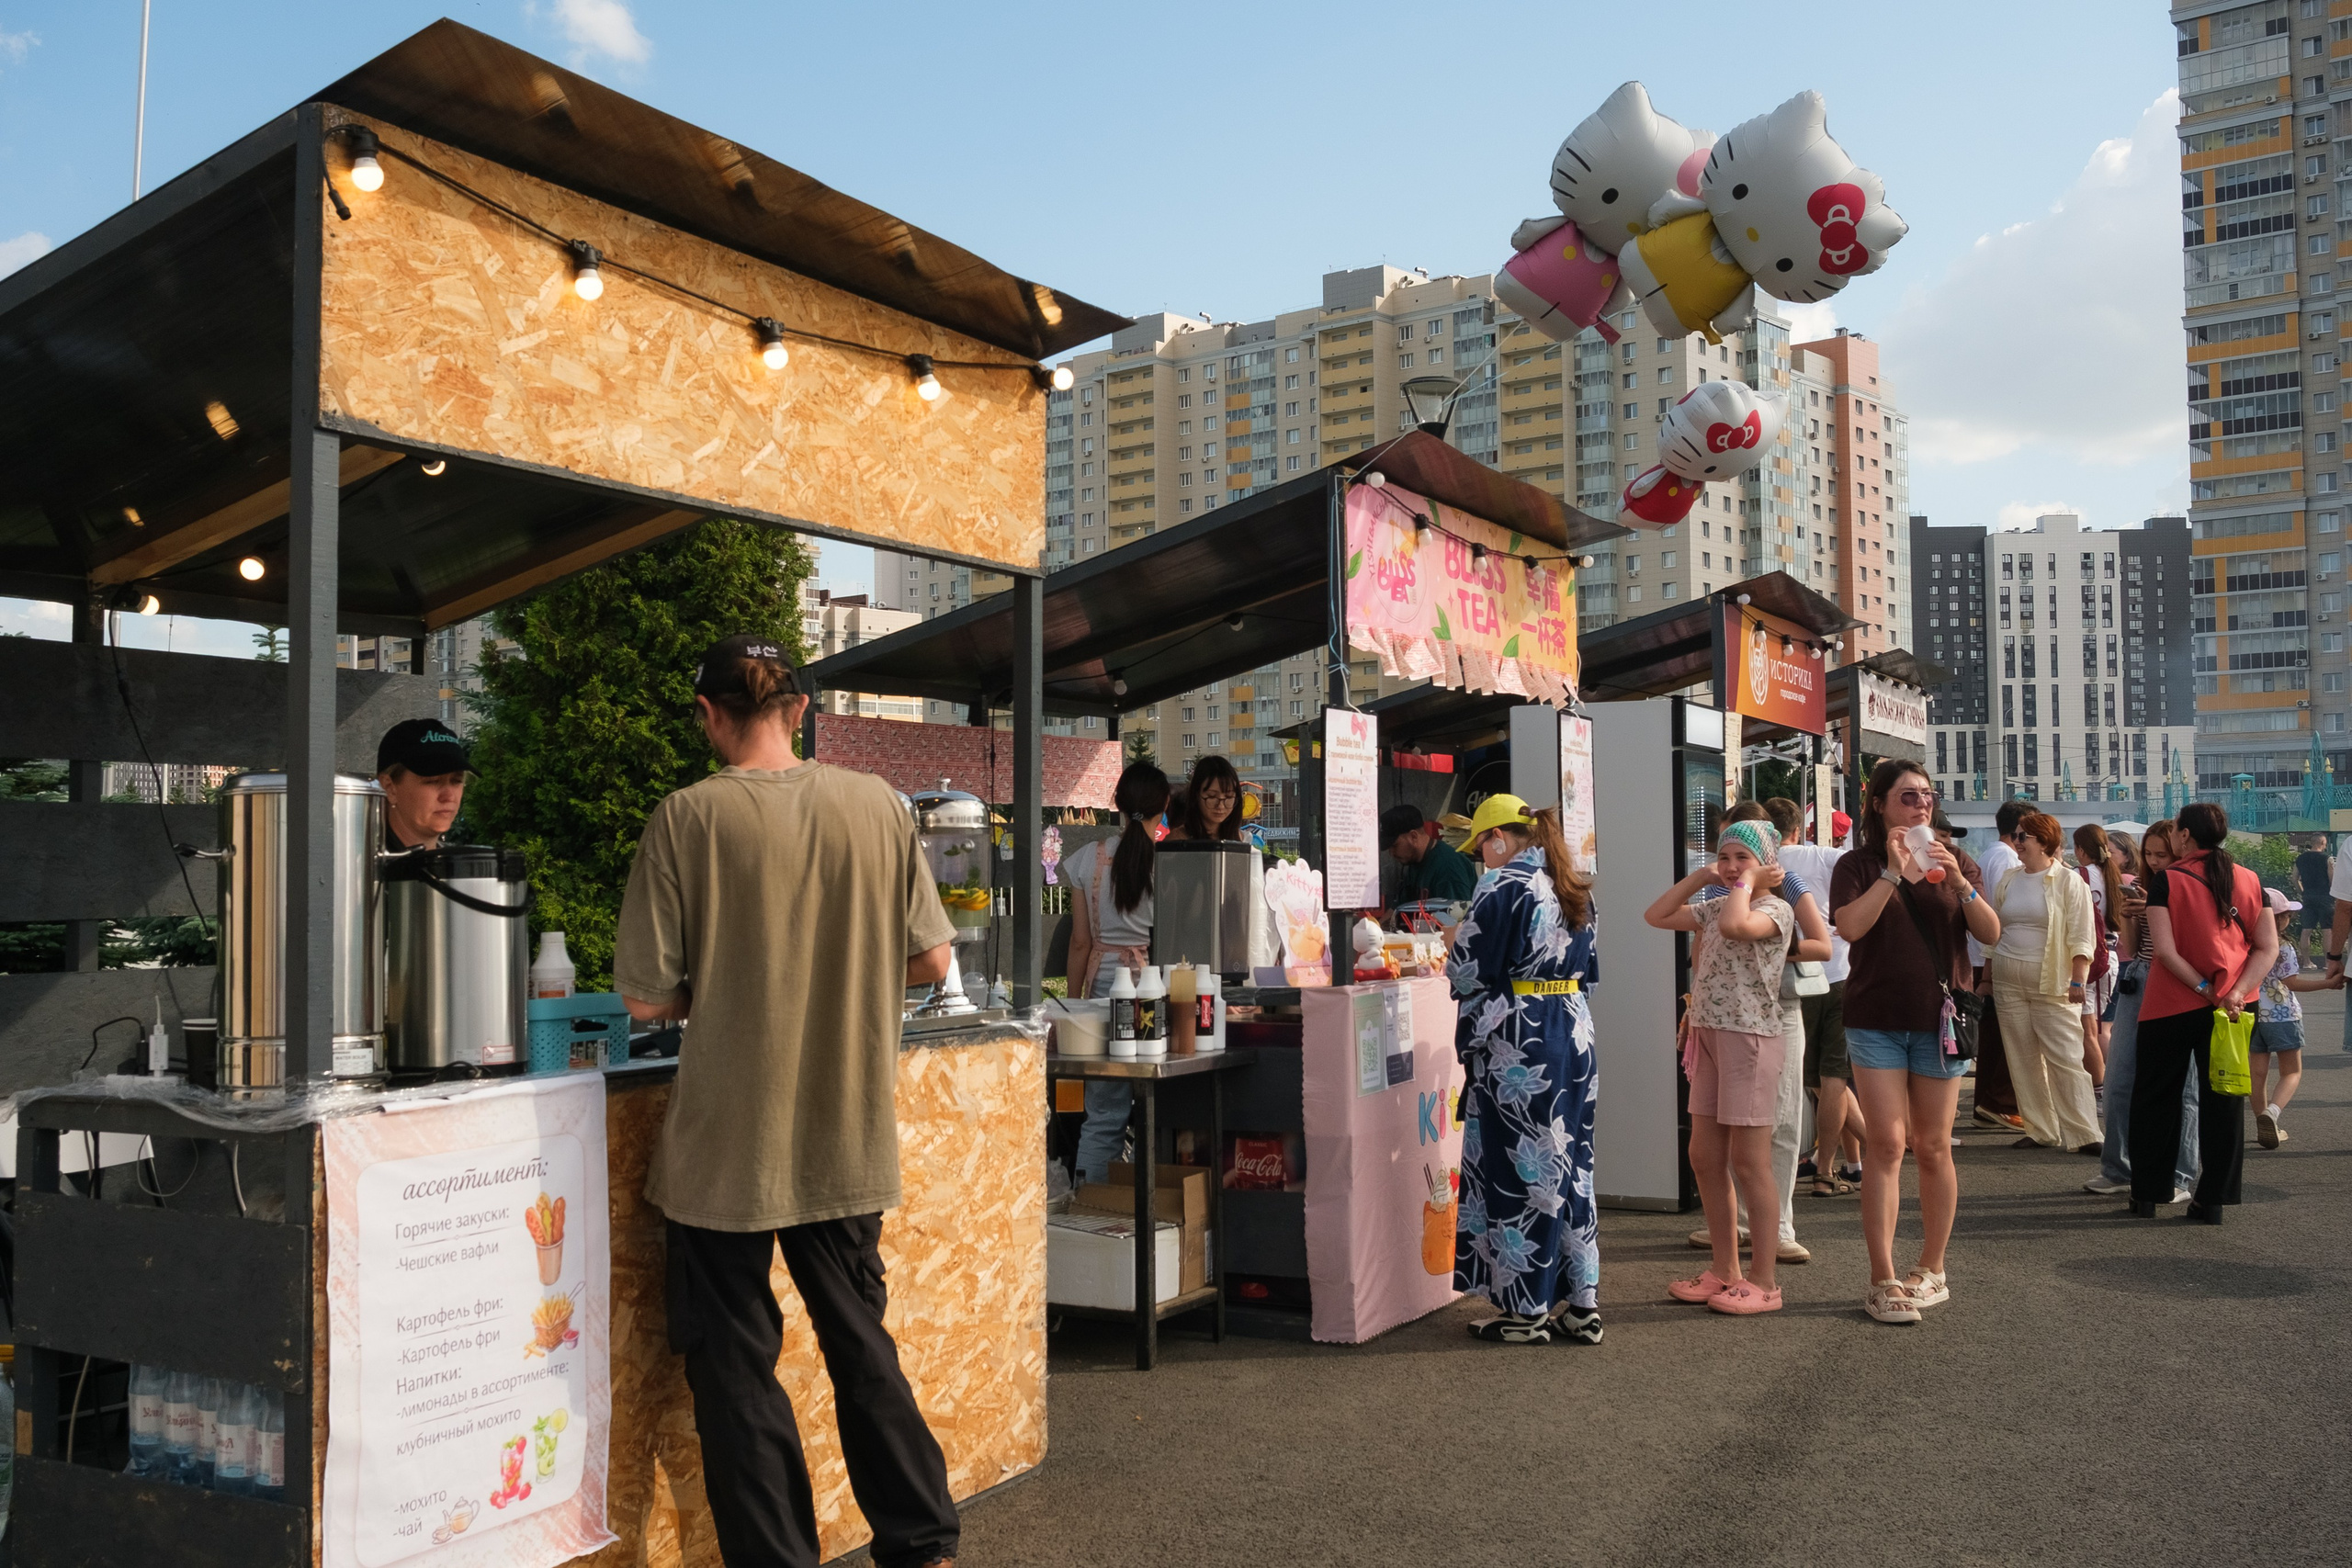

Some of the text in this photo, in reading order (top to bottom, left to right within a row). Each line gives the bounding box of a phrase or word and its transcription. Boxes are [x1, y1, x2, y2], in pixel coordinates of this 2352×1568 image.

[1377, 550, 1416, 591] BLISS
[1457, 588, 1501, 638] TEA
[746, 645, 778, 658] 부산
[1521, 616, 1567, 660] 一杯茶
[1770, 659, 1813, 691] ИСТОРИКА
[1337, 736, 1362, 750] Bubble tea
[1286, 873, 1314, 897] Kitty
[1533, 981, 1569, 993] DANGER
[402, 1156, 548, 1203] ассортимент:
[1235, 1152, 1283, 1177] Coca-Cola
[395, 1207, 510, 1241] Горячие закуски:
[395, 1241, 499, 1272] -Чешские вафли
[396, 1297, 503, 1334] Картофель фри:
[398, 1329, 501, 1366] -Картофель фри
[396, 1366, 462, 1395] Напитки:
[396, 1361, 570, 1419] -лимонады в ассортименте:
[396, 1408, 522, 1457] клубничный мохито
[393, 1490, 447, 1516] -мохито
[392, 1517, 423, 1539] -чай
